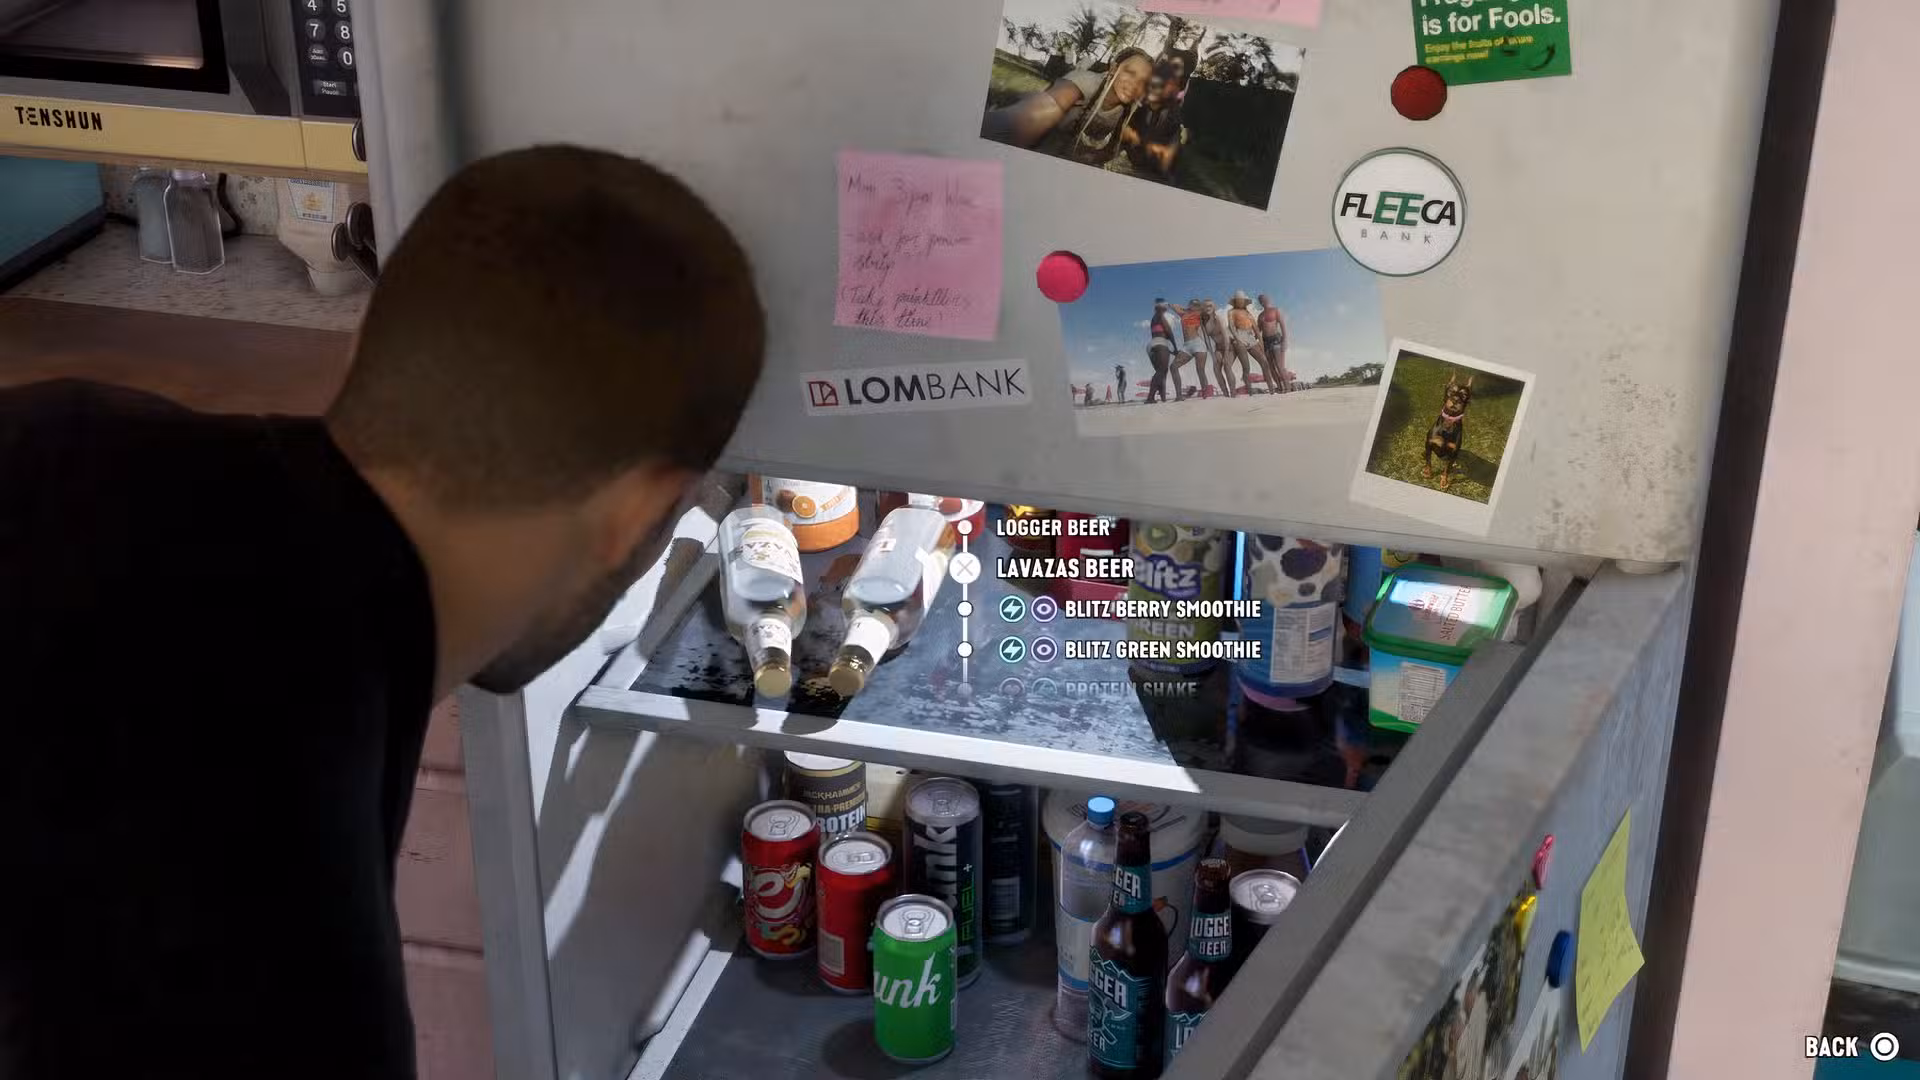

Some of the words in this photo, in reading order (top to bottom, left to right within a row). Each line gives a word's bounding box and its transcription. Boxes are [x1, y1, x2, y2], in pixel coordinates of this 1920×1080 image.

[307, 0, 318, 11] 4
[336, 0, 347, 13] 5
[1422, 14, 1443, 36] is
[1447, 11, 1483, 33] for
[1488, 3, 1562, 29] Fools.
[309, 23, 319, 38] 7
[340, 25, 350, 40] 8
[343, 51, 353, 65] 0
[14, 106, 103, 131] TENSHUN
[1340, 190, 1456, 227] FLEECA
[1359, 228, 1432, 245] BANK
[844, 367, 1026, 405] LOMBANK
